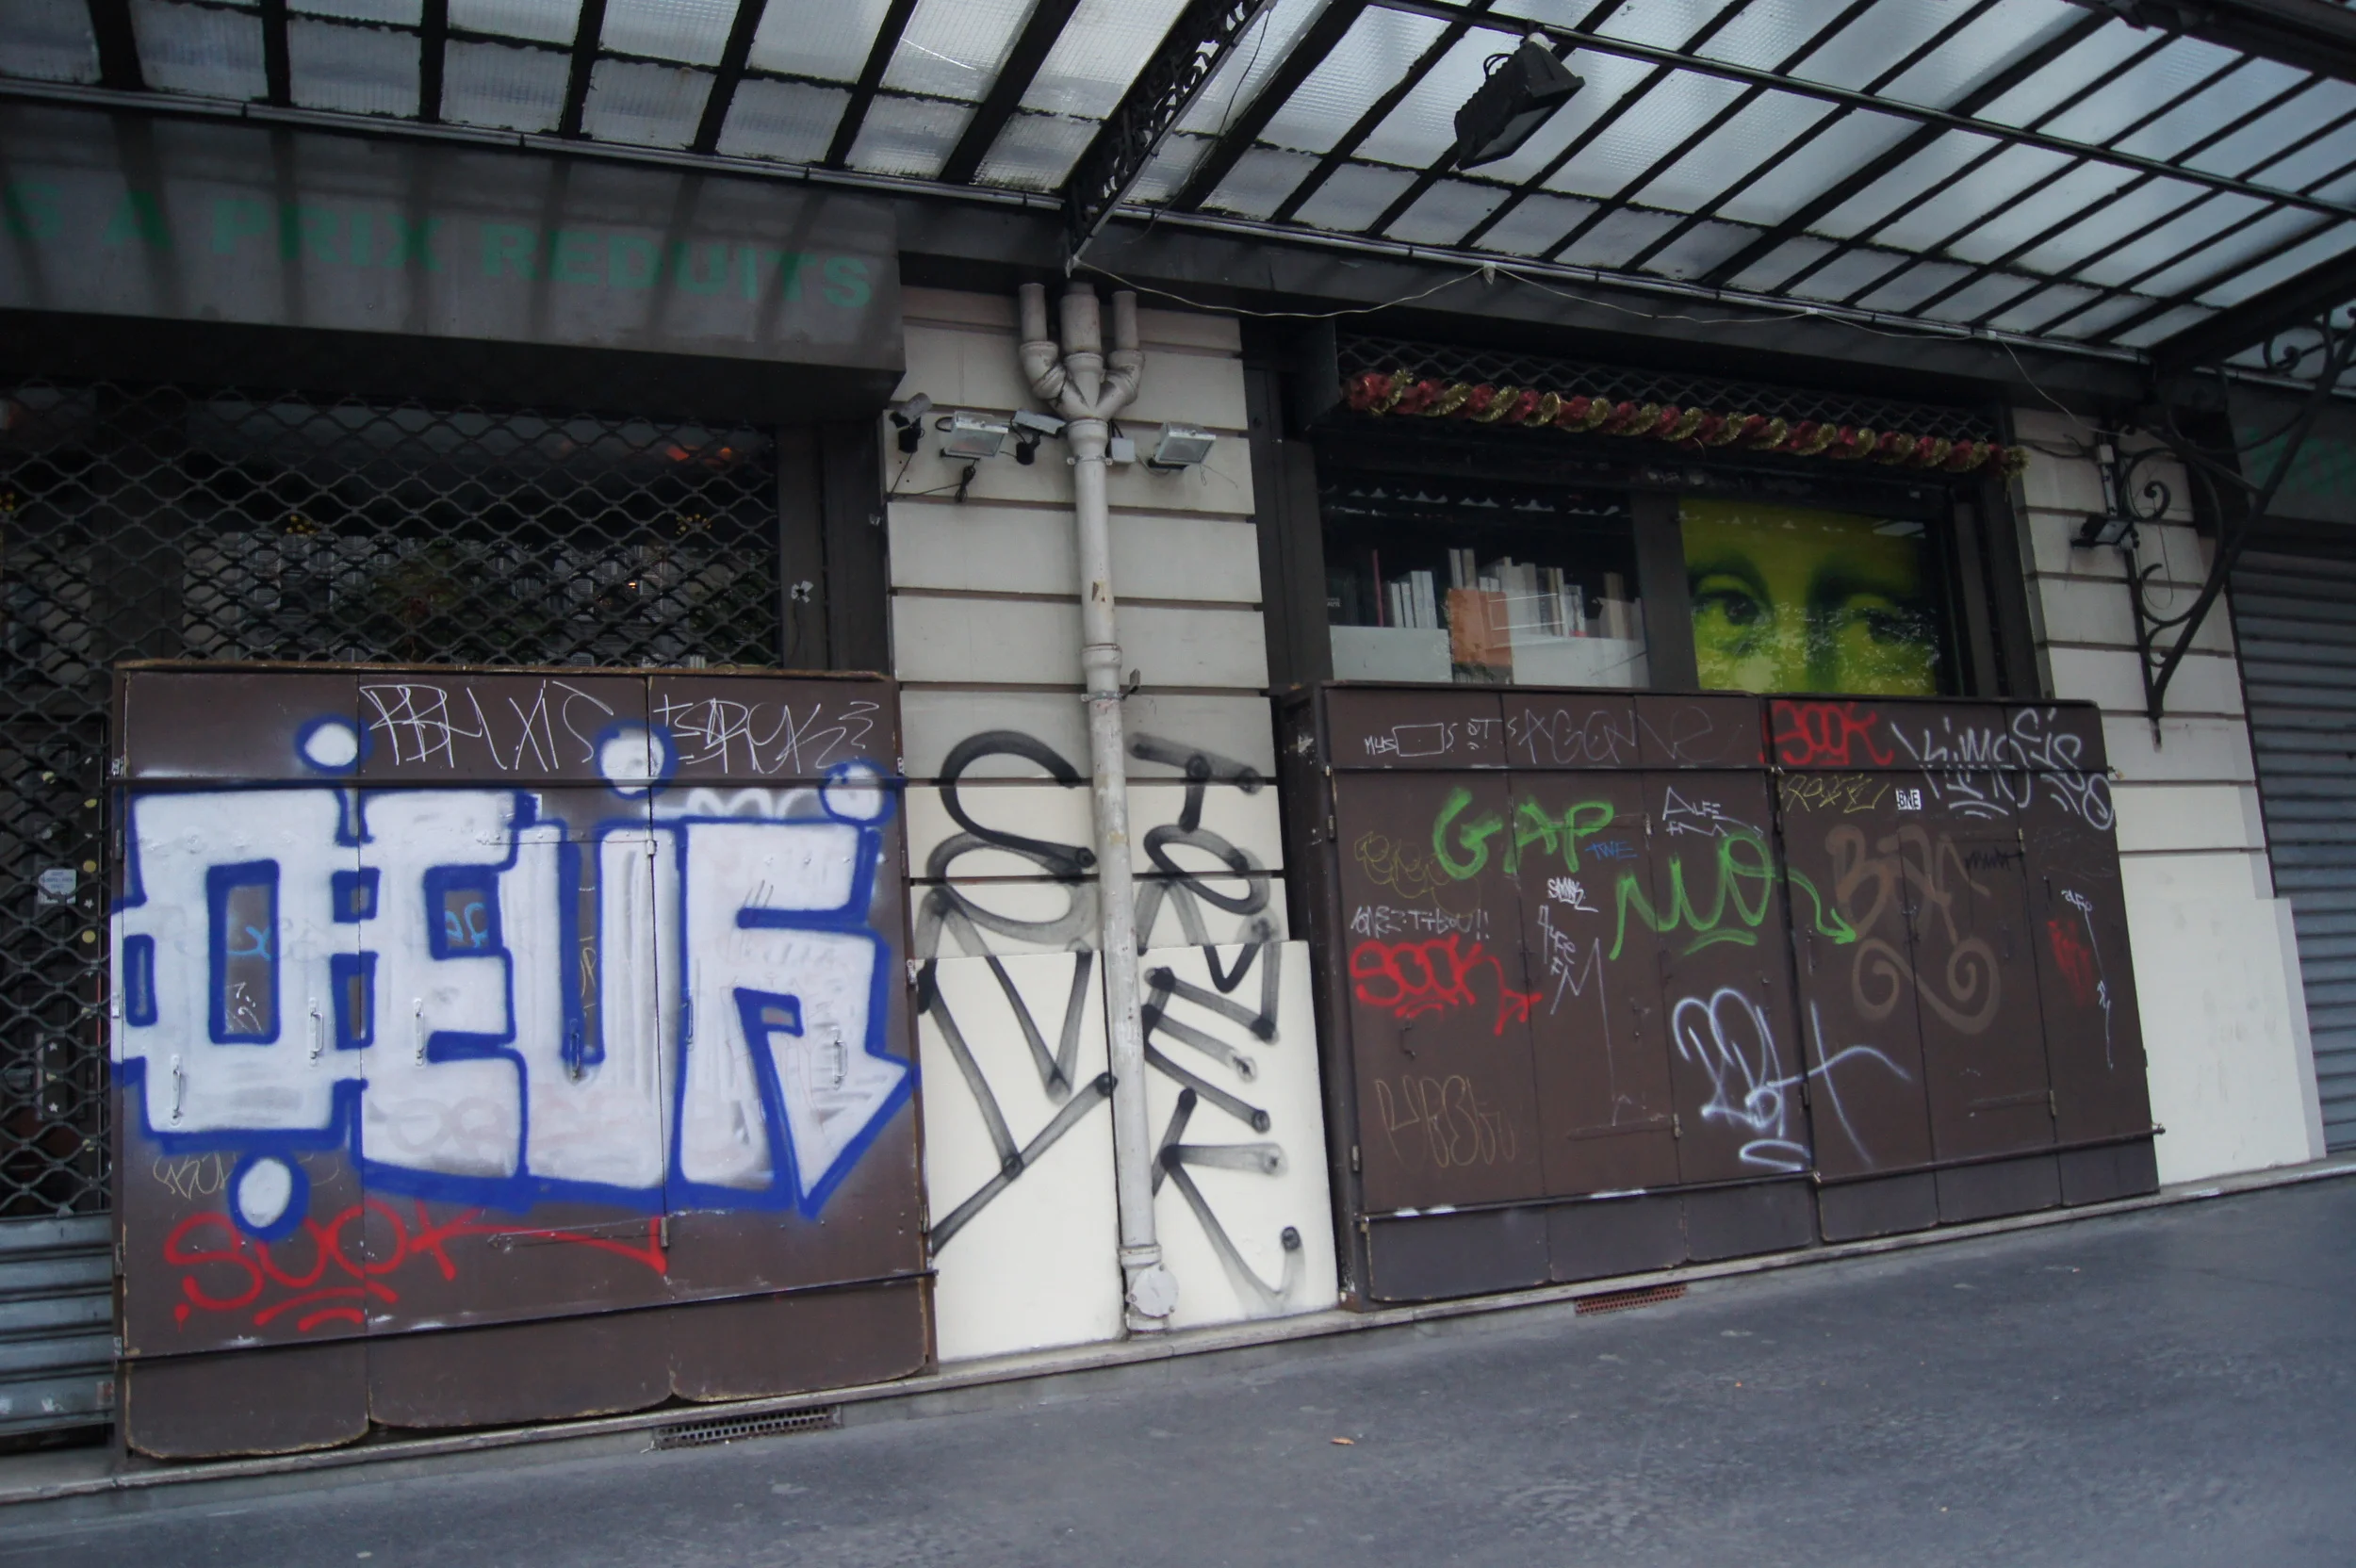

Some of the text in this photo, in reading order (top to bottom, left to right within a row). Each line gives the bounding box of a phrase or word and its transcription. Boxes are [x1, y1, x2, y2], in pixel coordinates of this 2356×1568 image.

[101, 188, 173, 253] A
[210, 199, 445, 274] PRIX
[479, 222, 874, 311] REDUITS
[1897, 791, 1922, 808] BNE
